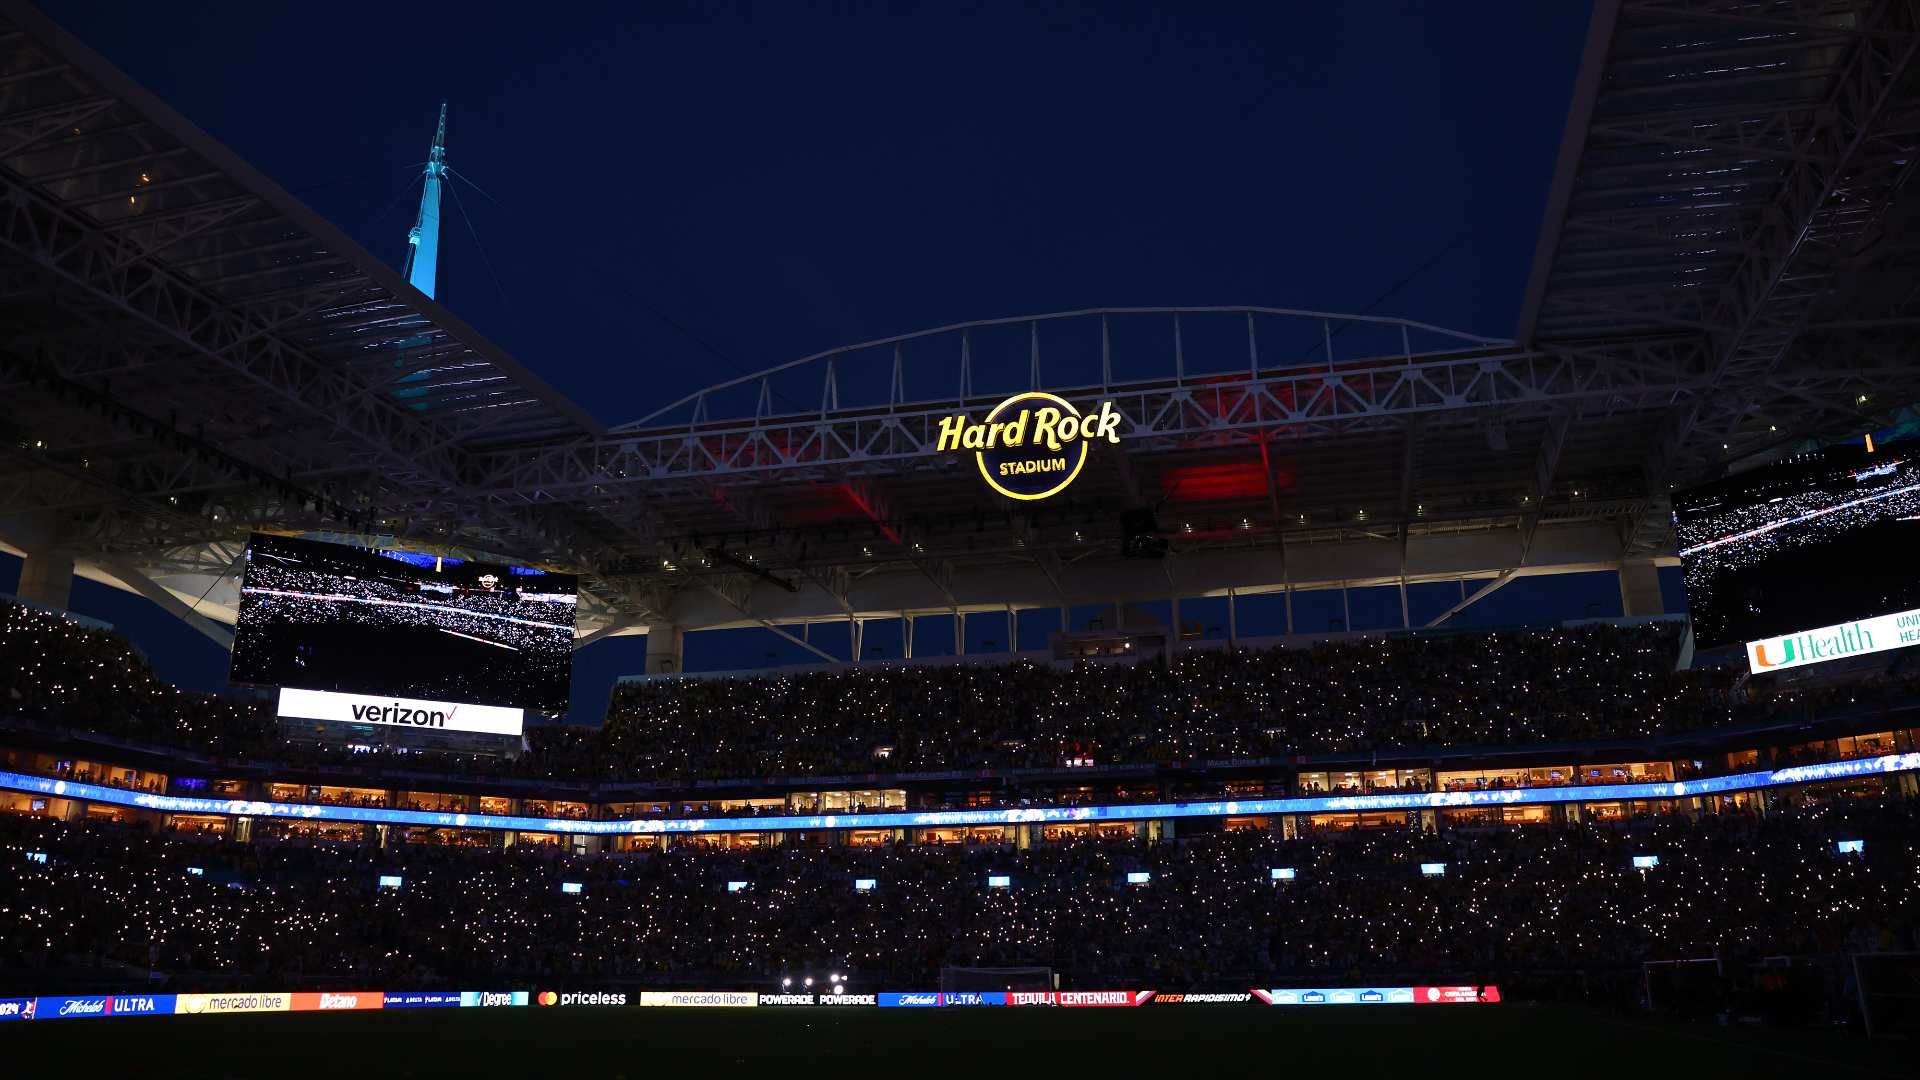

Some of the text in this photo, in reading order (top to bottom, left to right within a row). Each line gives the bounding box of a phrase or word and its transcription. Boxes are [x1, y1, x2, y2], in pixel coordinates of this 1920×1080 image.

[937, 402, 1121, 451] Hard Rock
[1000, 458, 1066, 475] STADIUM
[1896, 614, 1920, 628] UNI
[352, 702, 444, 727] verizon
[114, 998, 154, 1012] ULTRA
[209, 995, 281, 1009] mercado libre
[483, 991, 512, 1006] Degree
[560, 991, 626, 1005] priceless
[672, 993, 748, 1004] mercado libre
[759, 994, 876, 1005] POWERADE POWERADE
[1012, 992, 1057, 1006] TEQUILA
